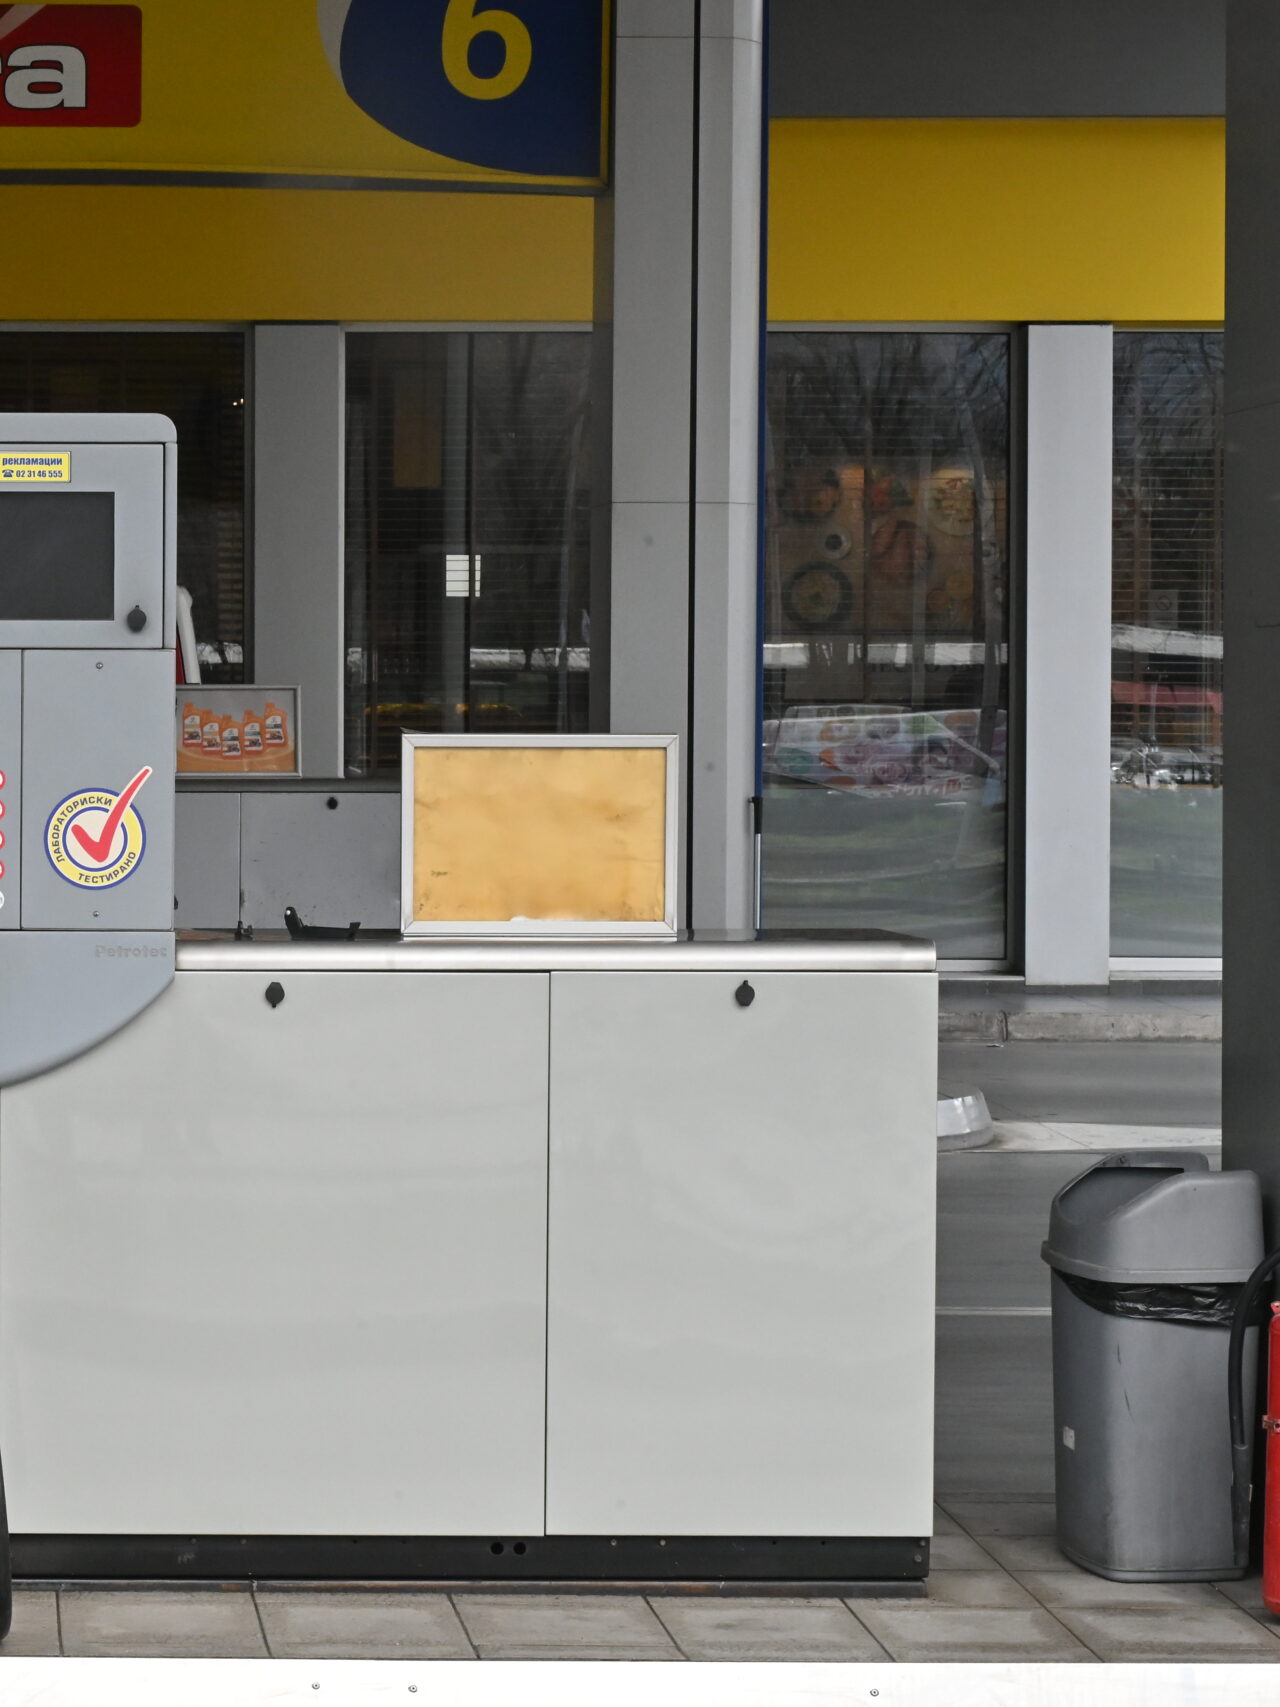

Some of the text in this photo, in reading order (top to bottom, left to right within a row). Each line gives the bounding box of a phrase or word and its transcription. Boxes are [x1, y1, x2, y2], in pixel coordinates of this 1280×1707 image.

[441, 0, 532, 101] 6
[2, 457, 62, 466] рекламации
[16, 470, 26, 478] 02
[48, 470, 63, 478] 555
[51, 796, 112, 862] ЛАБОРАТОРИСКИ
[78, 851, 136, 884] ТЕСТИРАНО
